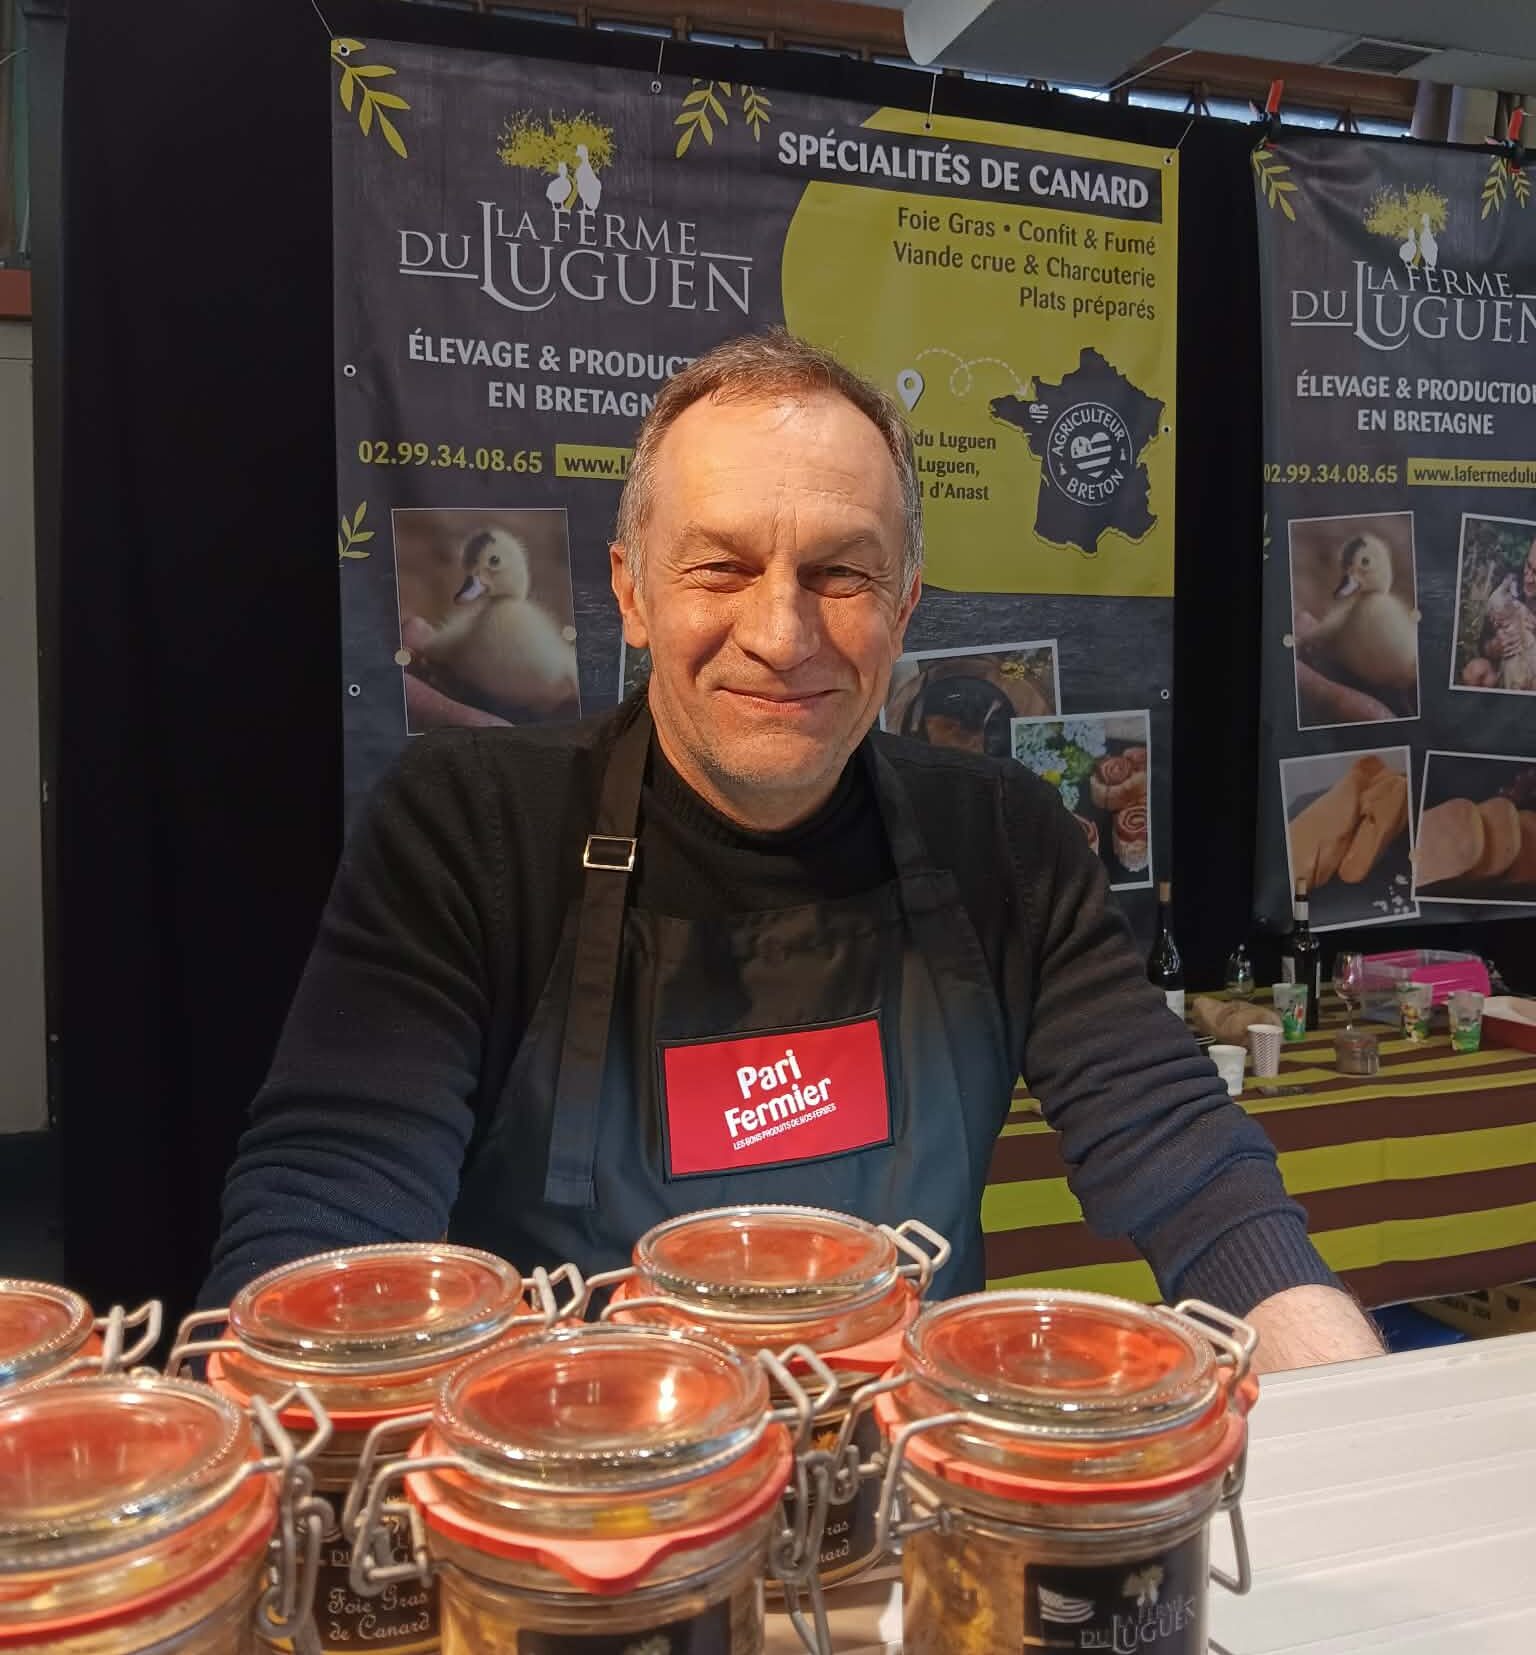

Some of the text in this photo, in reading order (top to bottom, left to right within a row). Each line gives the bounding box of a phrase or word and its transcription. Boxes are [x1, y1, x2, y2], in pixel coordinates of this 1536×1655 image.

[777, 128, 1149, 209] SPÉCIALITÉS DE CANARD
[495, 207, 698, 257] LA FERME
[897, 206, 1156, 256] Foie Gras Confit & Fumé
[398, 200, 753, 316] DU LUGUEN
[893, 240, 1156, 289] Viande crue & Charcuterie
[1366, 265, 1514, 299] LA FERME
[1019, 286, 1156, 321] Plats préparés
[1290, 290, 1348, 321] DU
[408, 328, 530, 369] ÉLEVAGE
[539, 345, 561, 372] &
[488, 381, 526, 409] EN
[1296, 369, 1536, 405] ÉLEVAGE & PRODUCTIO
[1051, 407, 1126, 458] AGRICULTEUR
[1356, 409, 1495, 435] EN BRETAGNE
[357, 440, 632, 475] 02.99.34.08.65 www.l
[914, 428, 996, 453] du Luguen
[918, 456, 980, 478] Luguen,
[1263, 463, 1398, 483] 02.99.34.08.65
[929, 481, 991, 501] d'Anast
[1066, 468, 1125, 501] BRETON
[736, 1049, 802, 1100] Pari
[724, 1077, 832, 1138] Fermier
[824, 1520, 849, 1536] ras
[327, 1583, 428, 1615] Foie Gras
[329, 1611, 431, 1642] de Canard
